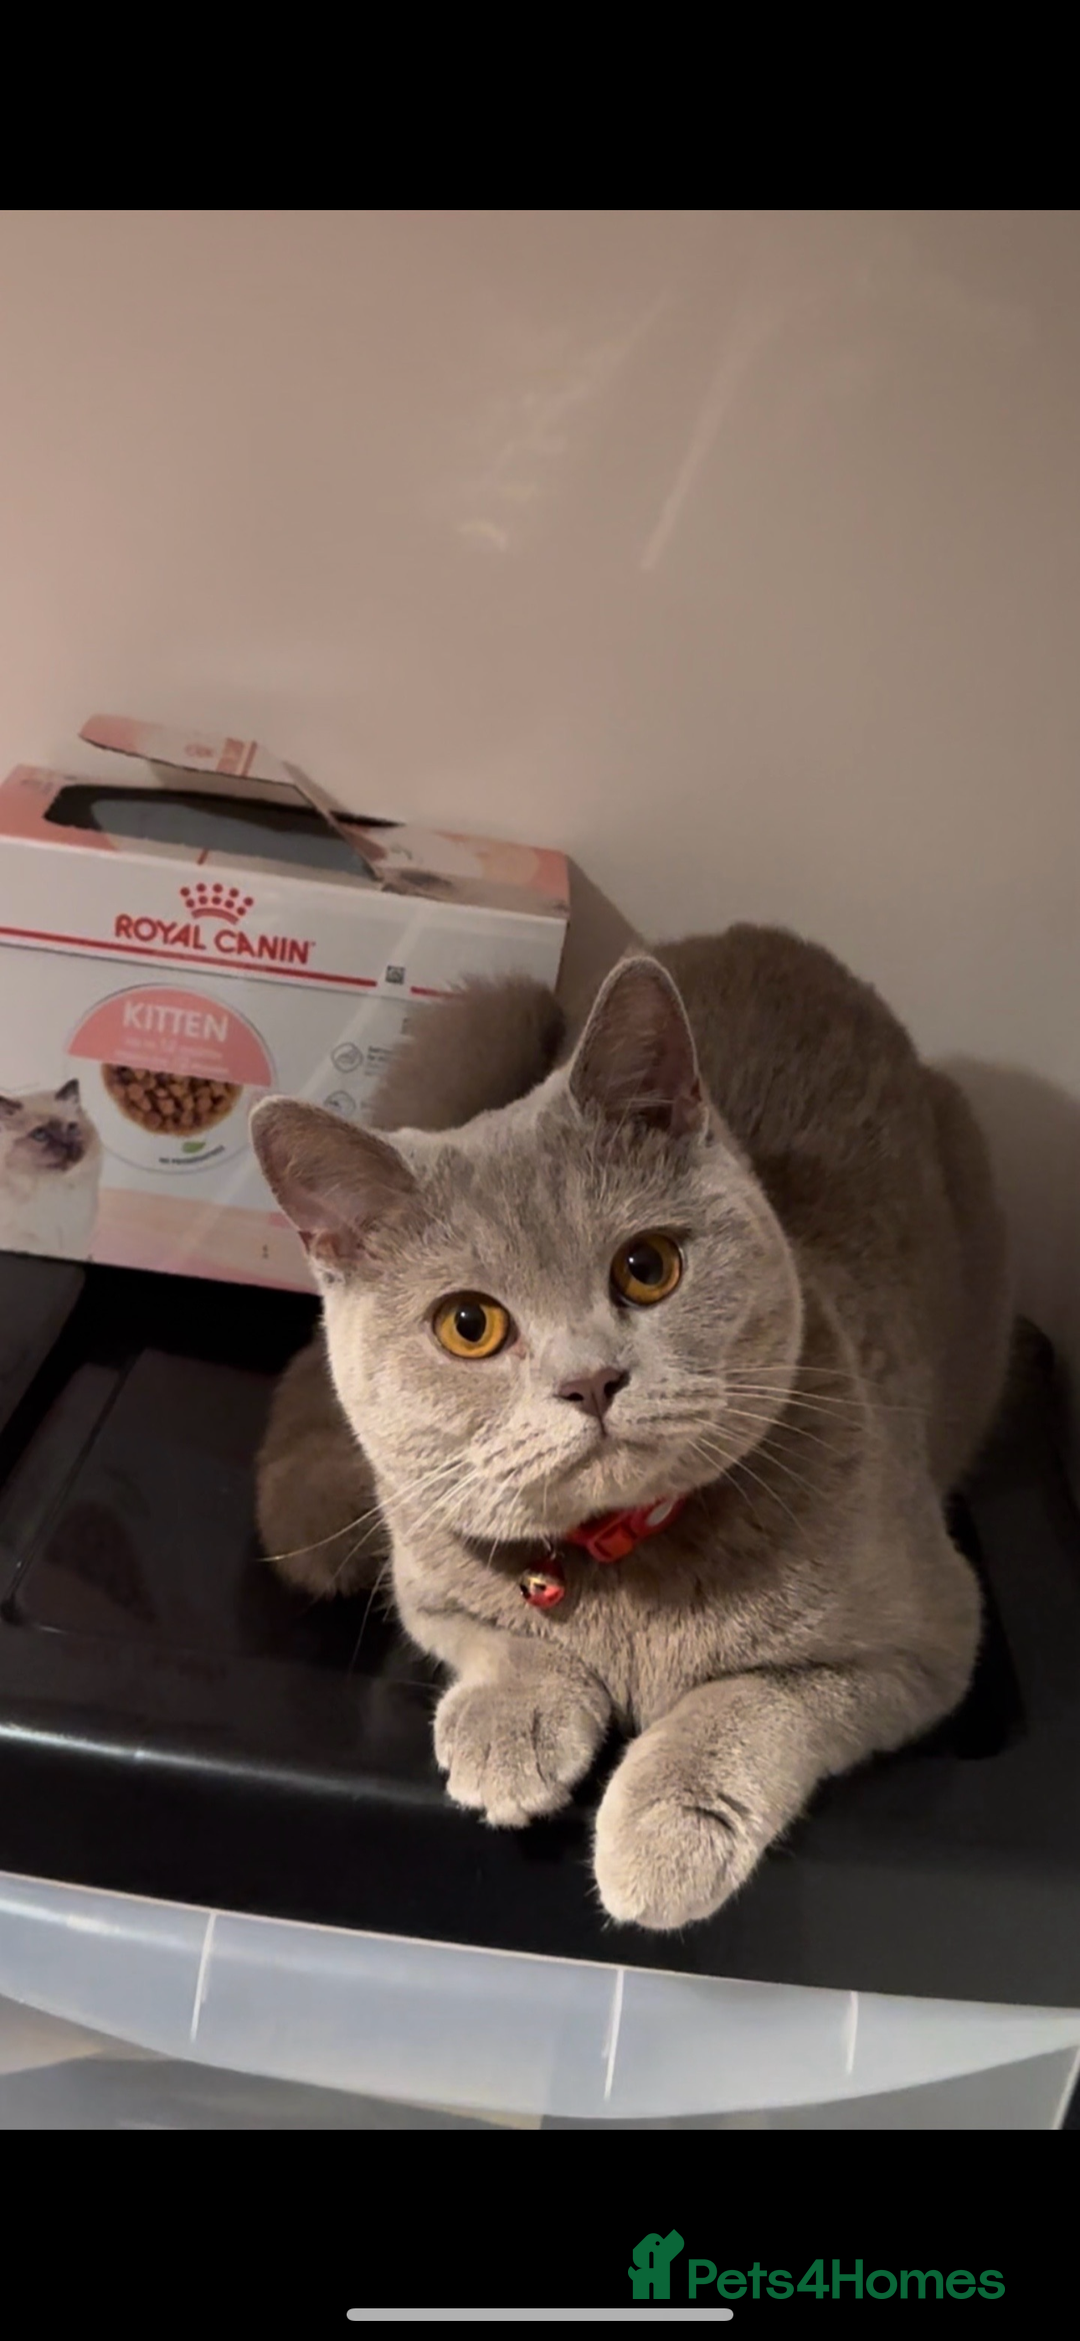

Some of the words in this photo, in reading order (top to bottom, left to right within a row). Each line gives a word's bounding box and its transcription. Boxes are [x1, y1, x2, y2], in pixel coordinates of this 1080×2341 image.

[115, 914, 206, 950] ROYAL
[214, 929, 310, 964] CANIN
[123, 1002, 229, 1043] KITTEN
